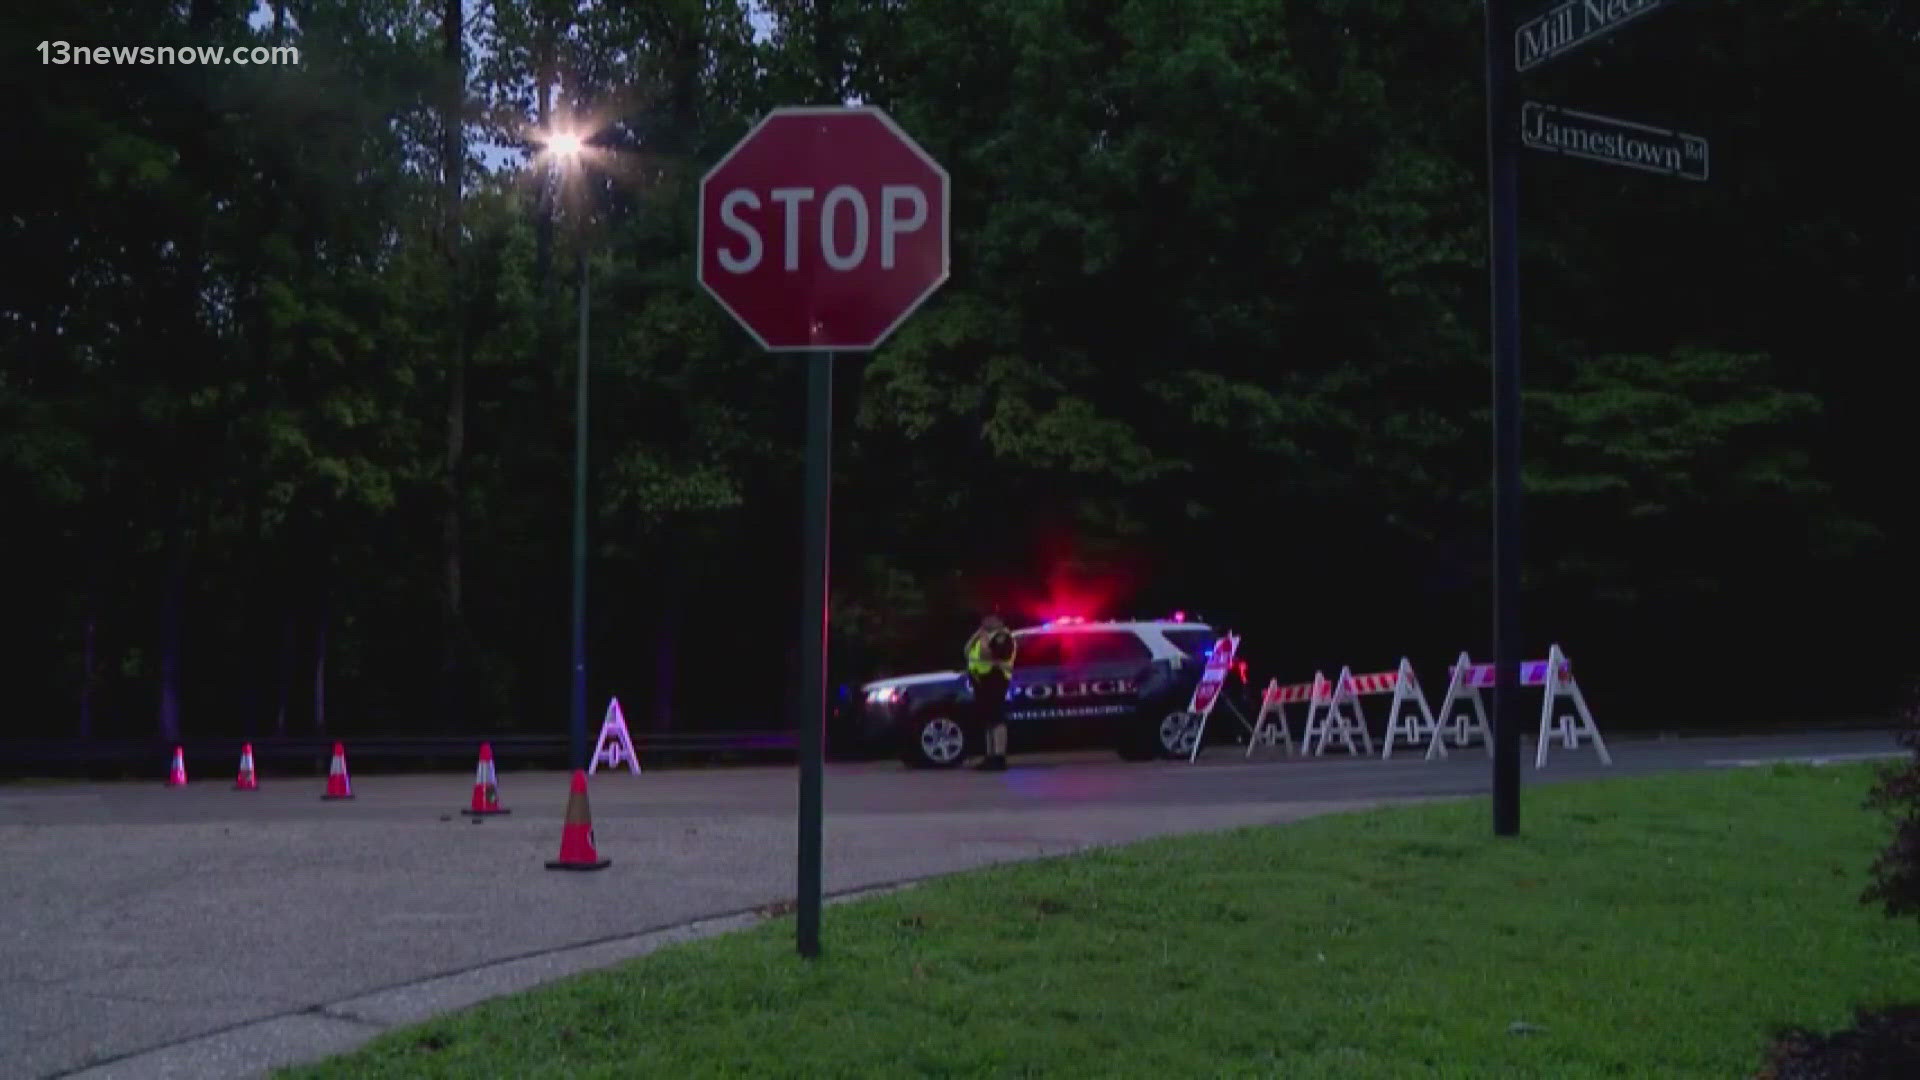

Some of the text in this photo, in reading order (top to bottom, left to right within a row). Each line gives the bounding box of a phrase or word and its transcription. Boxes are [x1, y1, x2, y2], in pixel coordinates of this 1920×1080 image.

[1523, 0, 1646, 62] Mill Nec
[1527, 111, 1681, 170] Jamestown
[717, 184, 929, 274] STOP
[1005, 679, 1137, 702] POLICE
